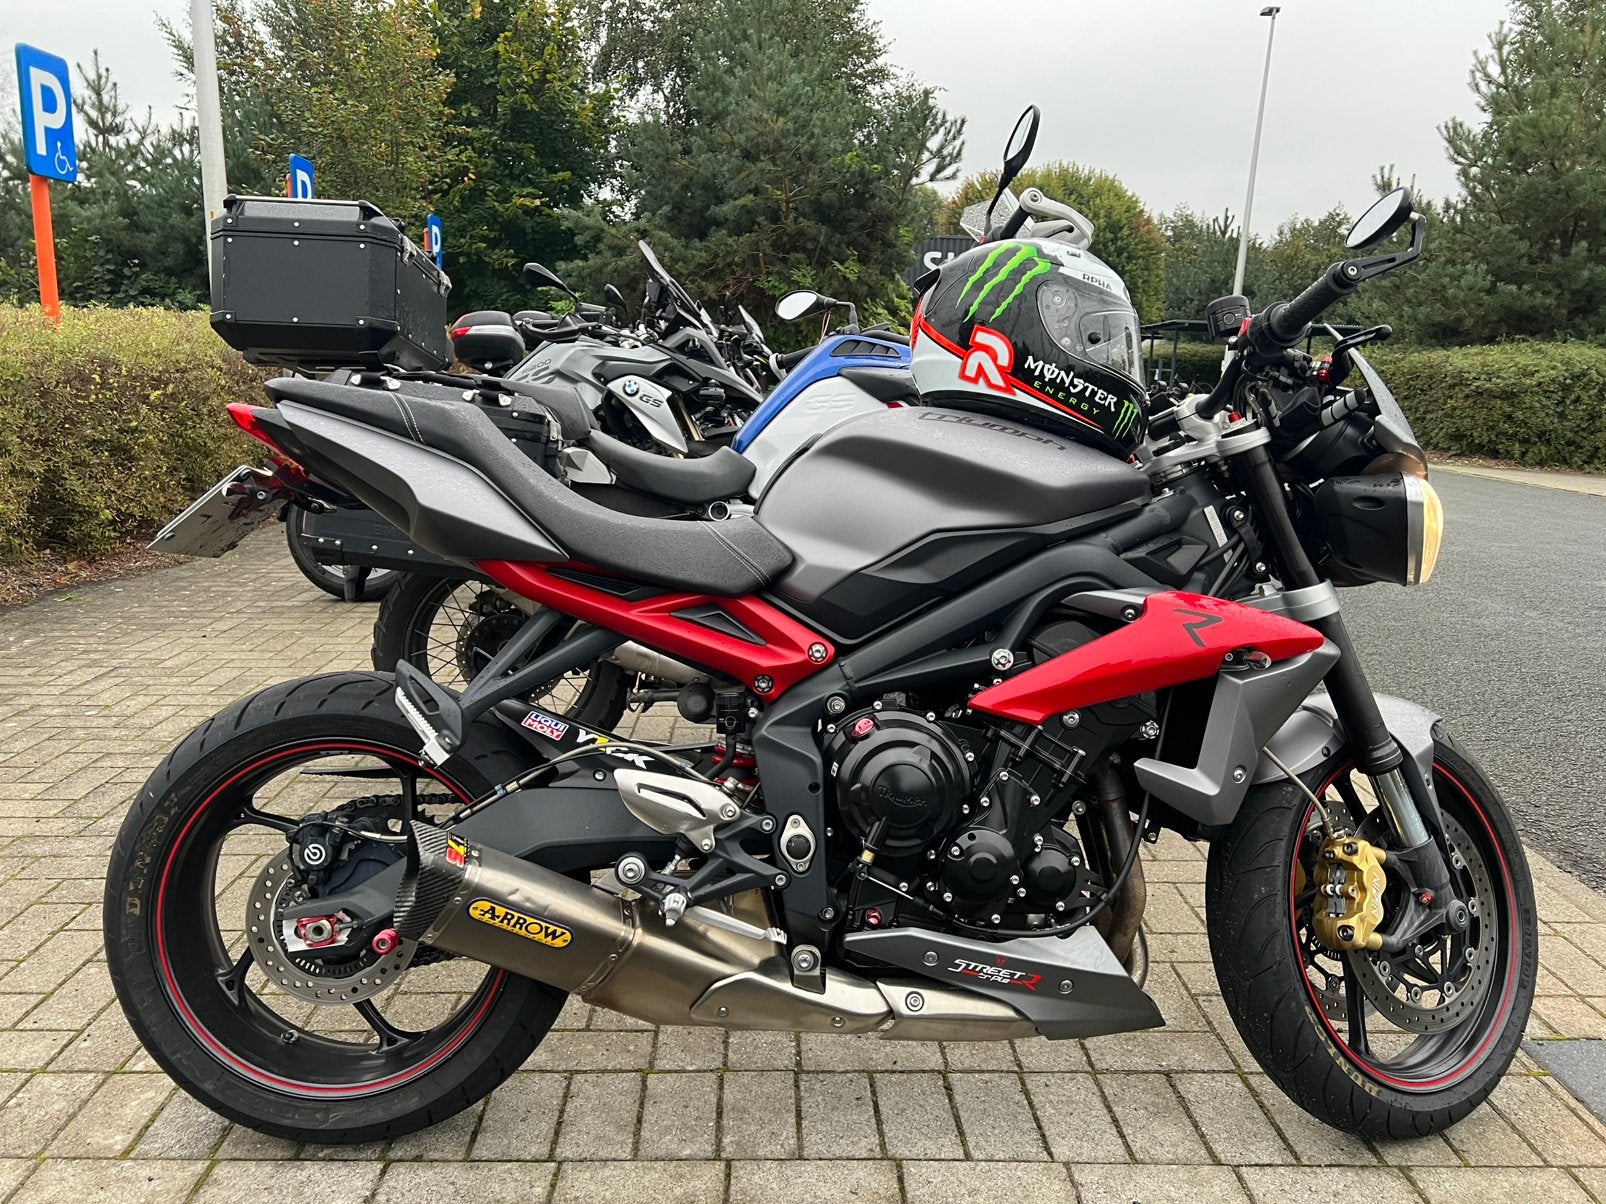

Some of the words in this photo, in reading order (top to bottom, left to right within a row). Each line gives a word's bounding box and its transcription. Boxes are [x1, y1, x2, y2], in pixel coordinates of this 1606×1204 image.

[29, 65, 67, 156] P
[1082, 273, 1113, 292] RPHA
[1024, 355, 1118, 412] MONSTER
[639, 393, 664, 408] GS
[1033, 380, 1100, 415] ENERGY
[524, 717, 565, 740] MOLY
[529, 713, 568, 733] LIQUI
[478, 905, 567, 942] ARROW
[947, 958, 1026, 980] STREET
